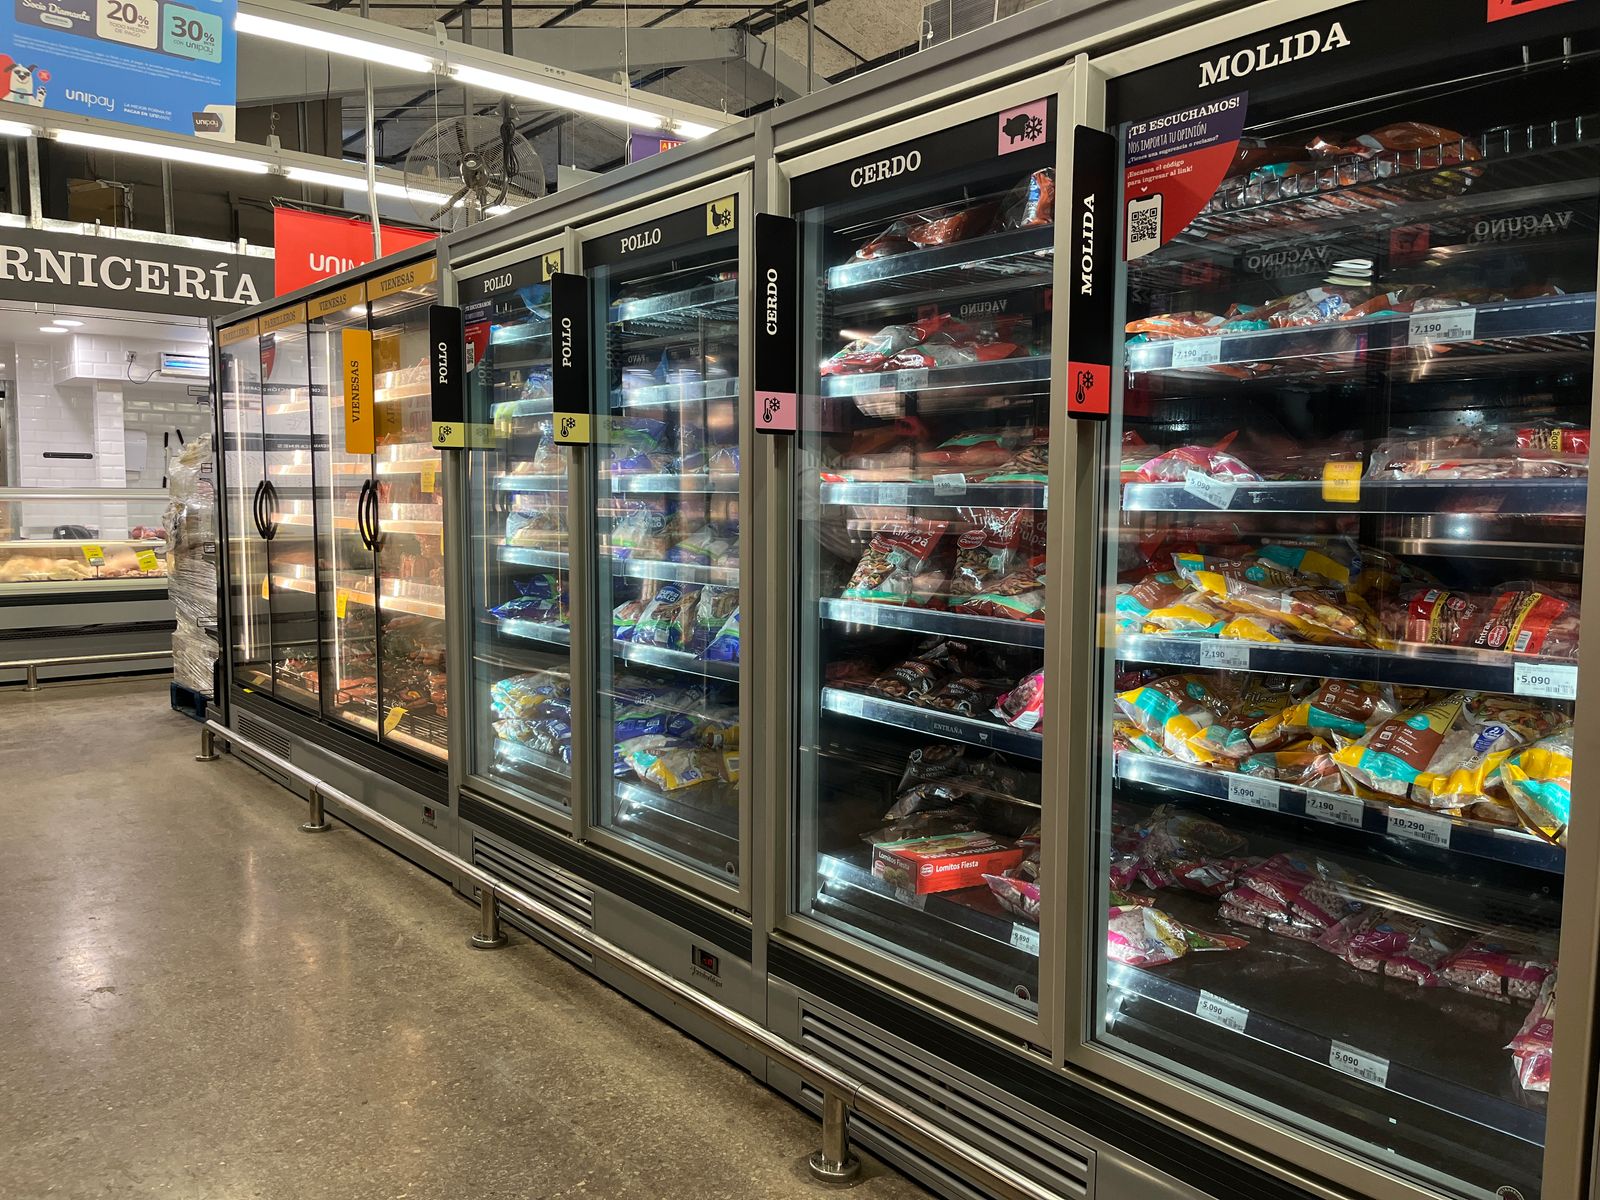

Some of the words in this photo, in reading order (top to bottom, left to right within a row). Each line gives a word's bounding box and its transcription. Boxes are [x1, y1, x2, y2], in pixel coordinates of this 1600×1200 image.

[48, 3, 91, 21] Diamante
[185, 41, 213, 56] unipay
[1199, 22, 1350, 88] MOLIDA
[65, 88, 115, 112] unipay
[195, 119, 219, 128] unipay
[1128, 123, 1147, 139] ¡TE
[1149, 97, 1240, 131] ESCUCHAMOS!
[1140, 134, 1168, 151] IMPORTA
[1168, 132, 1177, 143] TU
[1177, 121, 1207, 142] OPINIÓN
[850, 150, 922, 189] CERDO
[1162, 159, 1185, 171] código
[1127, 180, 1141, 188] para
[1142, 172, 1169, 184] ingresar
[620, 227, 662, 254] POLLO
[1081, 193, 1095, 296] MOLIDA
[379, 271, 415, 292] VIENESAS
[483, 273, 513, 294] POLLO
[318, 294, 347, 312] VIENESAS
[766, 268, 778, 336] CERDO
[561, 317, 572, 368] POLLO
[439, 341, 448, 385] POLLO
[350, 359, 361, 424] VIENESAS
[933, 722, 963, 736] ENTRAÑA
[878, 851, 896, 864] Lomitos
[935, 863, 960, 873] Lomitos
[960, 860, 979, 869] Fiesta
